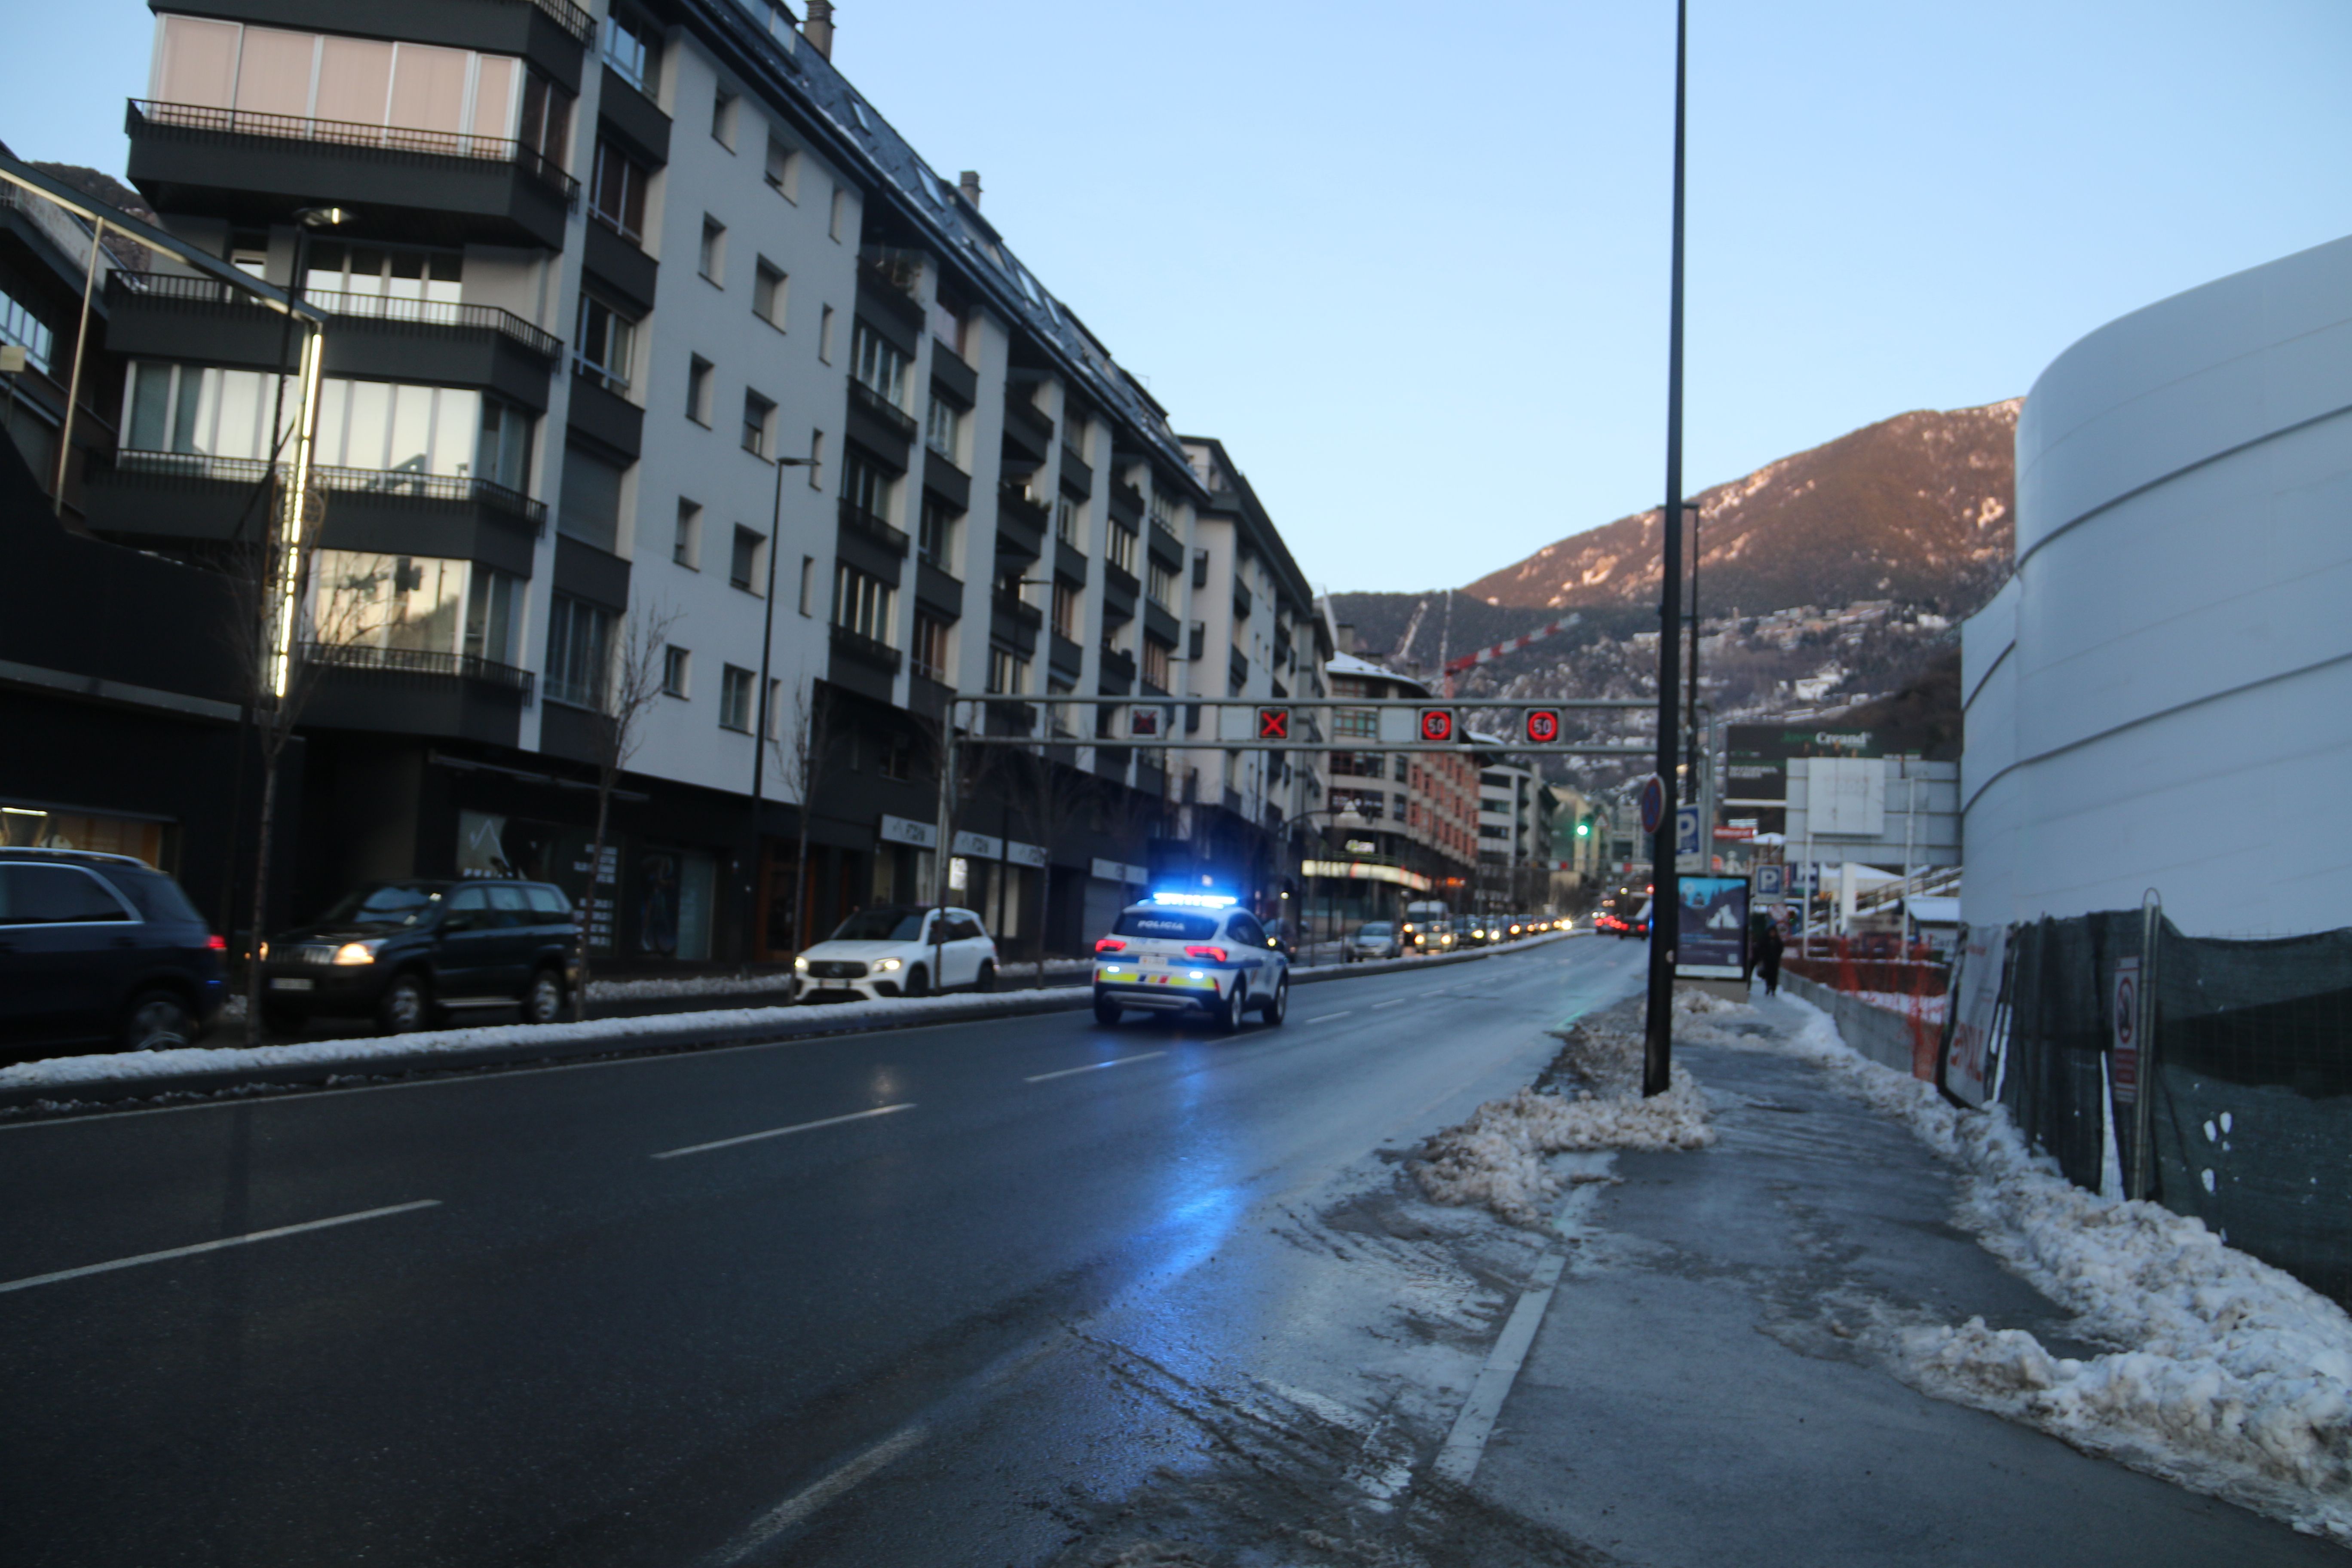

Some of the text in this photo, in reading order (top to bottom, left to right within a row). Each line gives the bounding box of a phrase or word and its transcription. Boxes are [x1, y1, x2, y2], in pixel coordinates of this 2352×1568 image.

[1427, 718, 1446, 732] 50
[1534, 719, 1552, 733] 50
[1676, 813, 1697, 850] P
[1761, 869, 1778, 892] P
